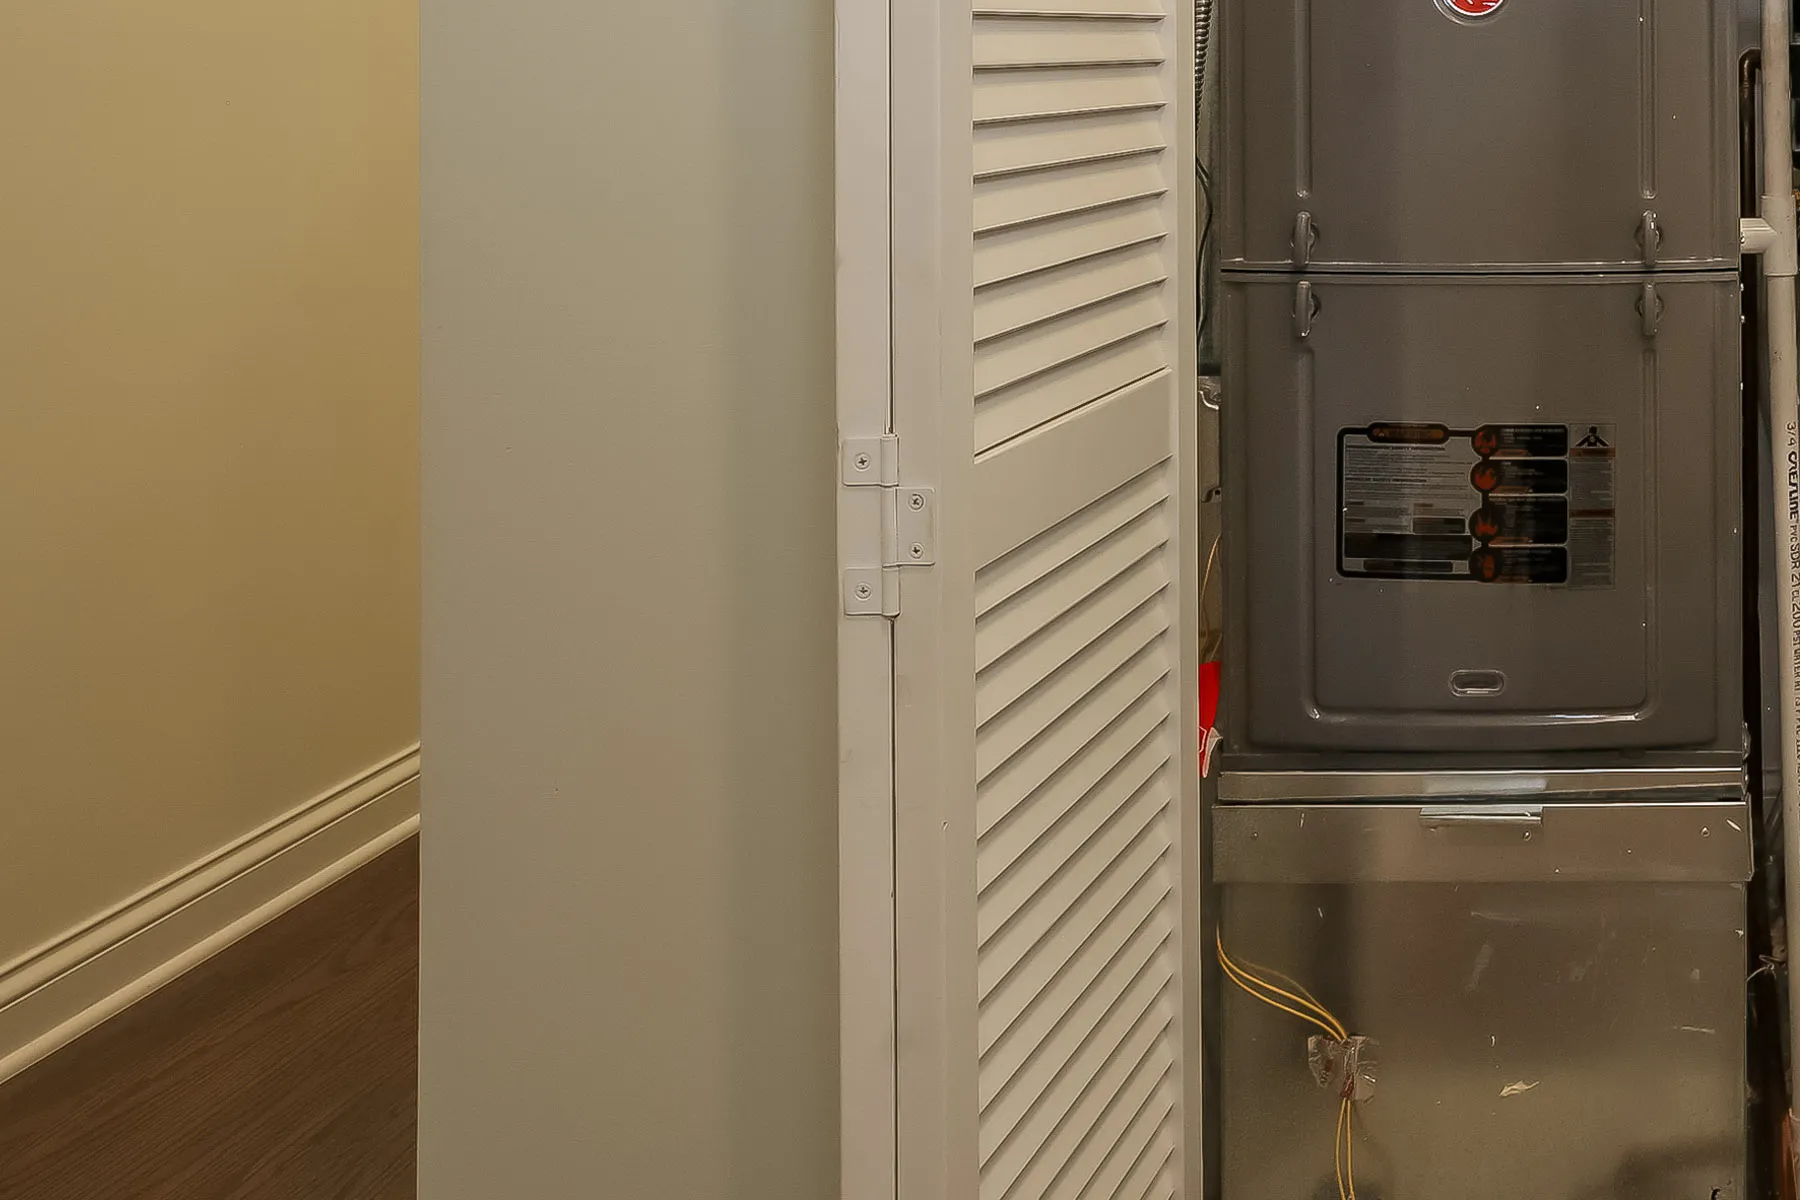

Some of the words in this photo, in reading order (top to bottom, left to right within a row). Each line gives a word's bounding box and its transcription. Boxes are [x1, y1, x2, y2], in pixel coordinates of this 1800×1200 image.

[1786, 421, 1797, 447] 3/4
[1789, 525, 1798, 543] PVC
[1789, 544, 1800, 570] SDR
[1791, 590, 1800, 601] CL
[1793, 629, 1800, 647] PSI
